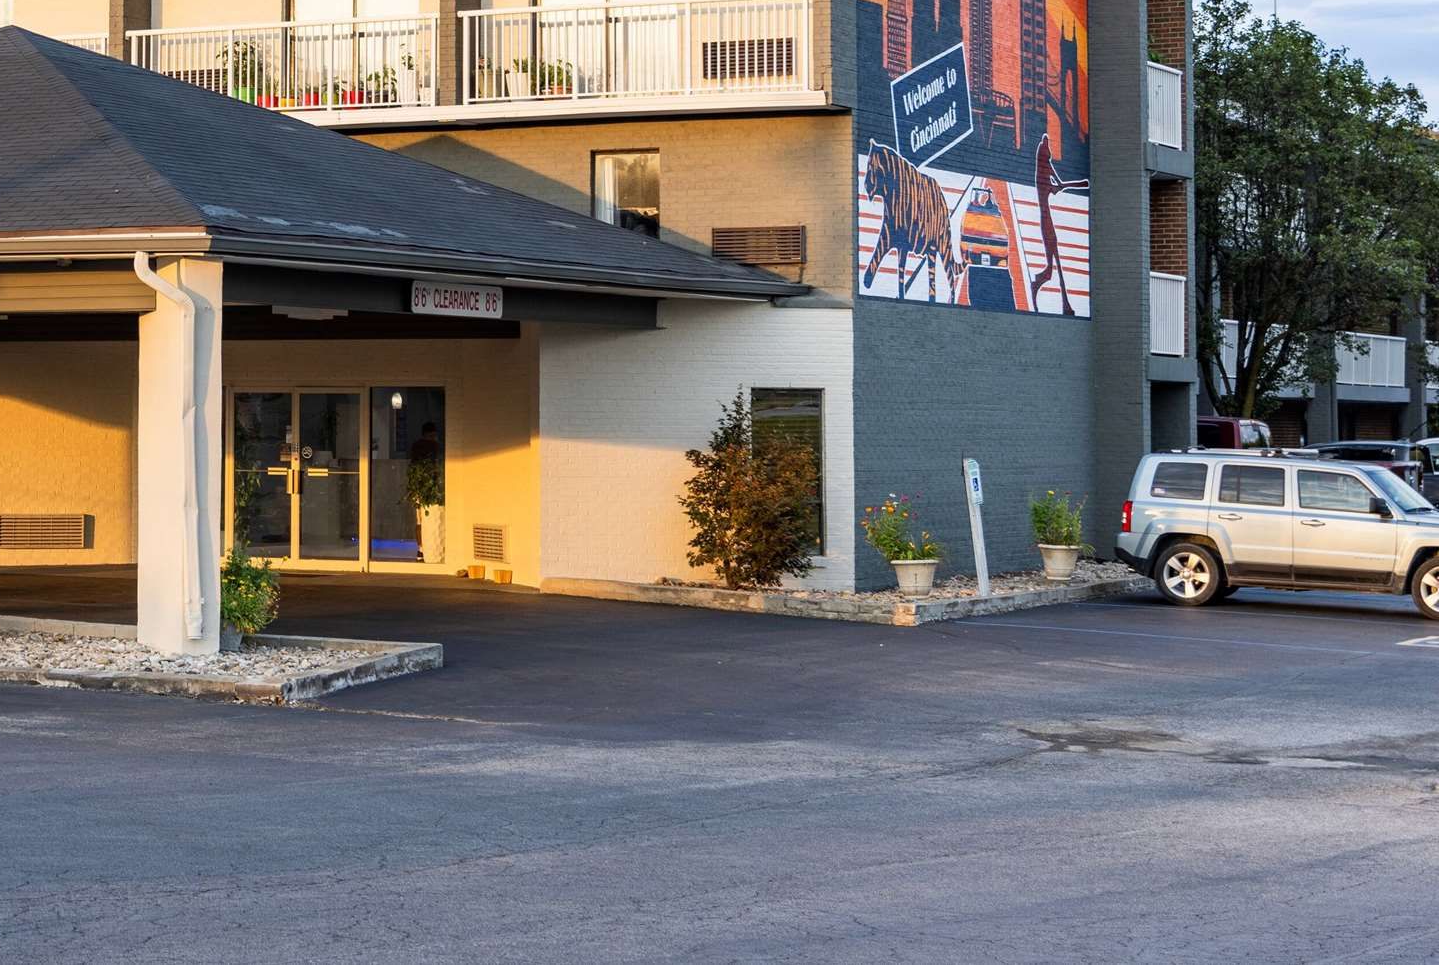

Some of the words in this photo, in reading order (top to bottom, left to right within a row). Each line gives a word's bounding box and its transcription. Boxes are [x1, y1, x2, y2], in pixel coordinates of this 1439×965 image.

[902, 75, 945, 116] Welcome
[946, 66, 957, 89] to
[910, 100, 958, 153] Cincinnati
[433, 288, 480, 311] CLEARANCE
